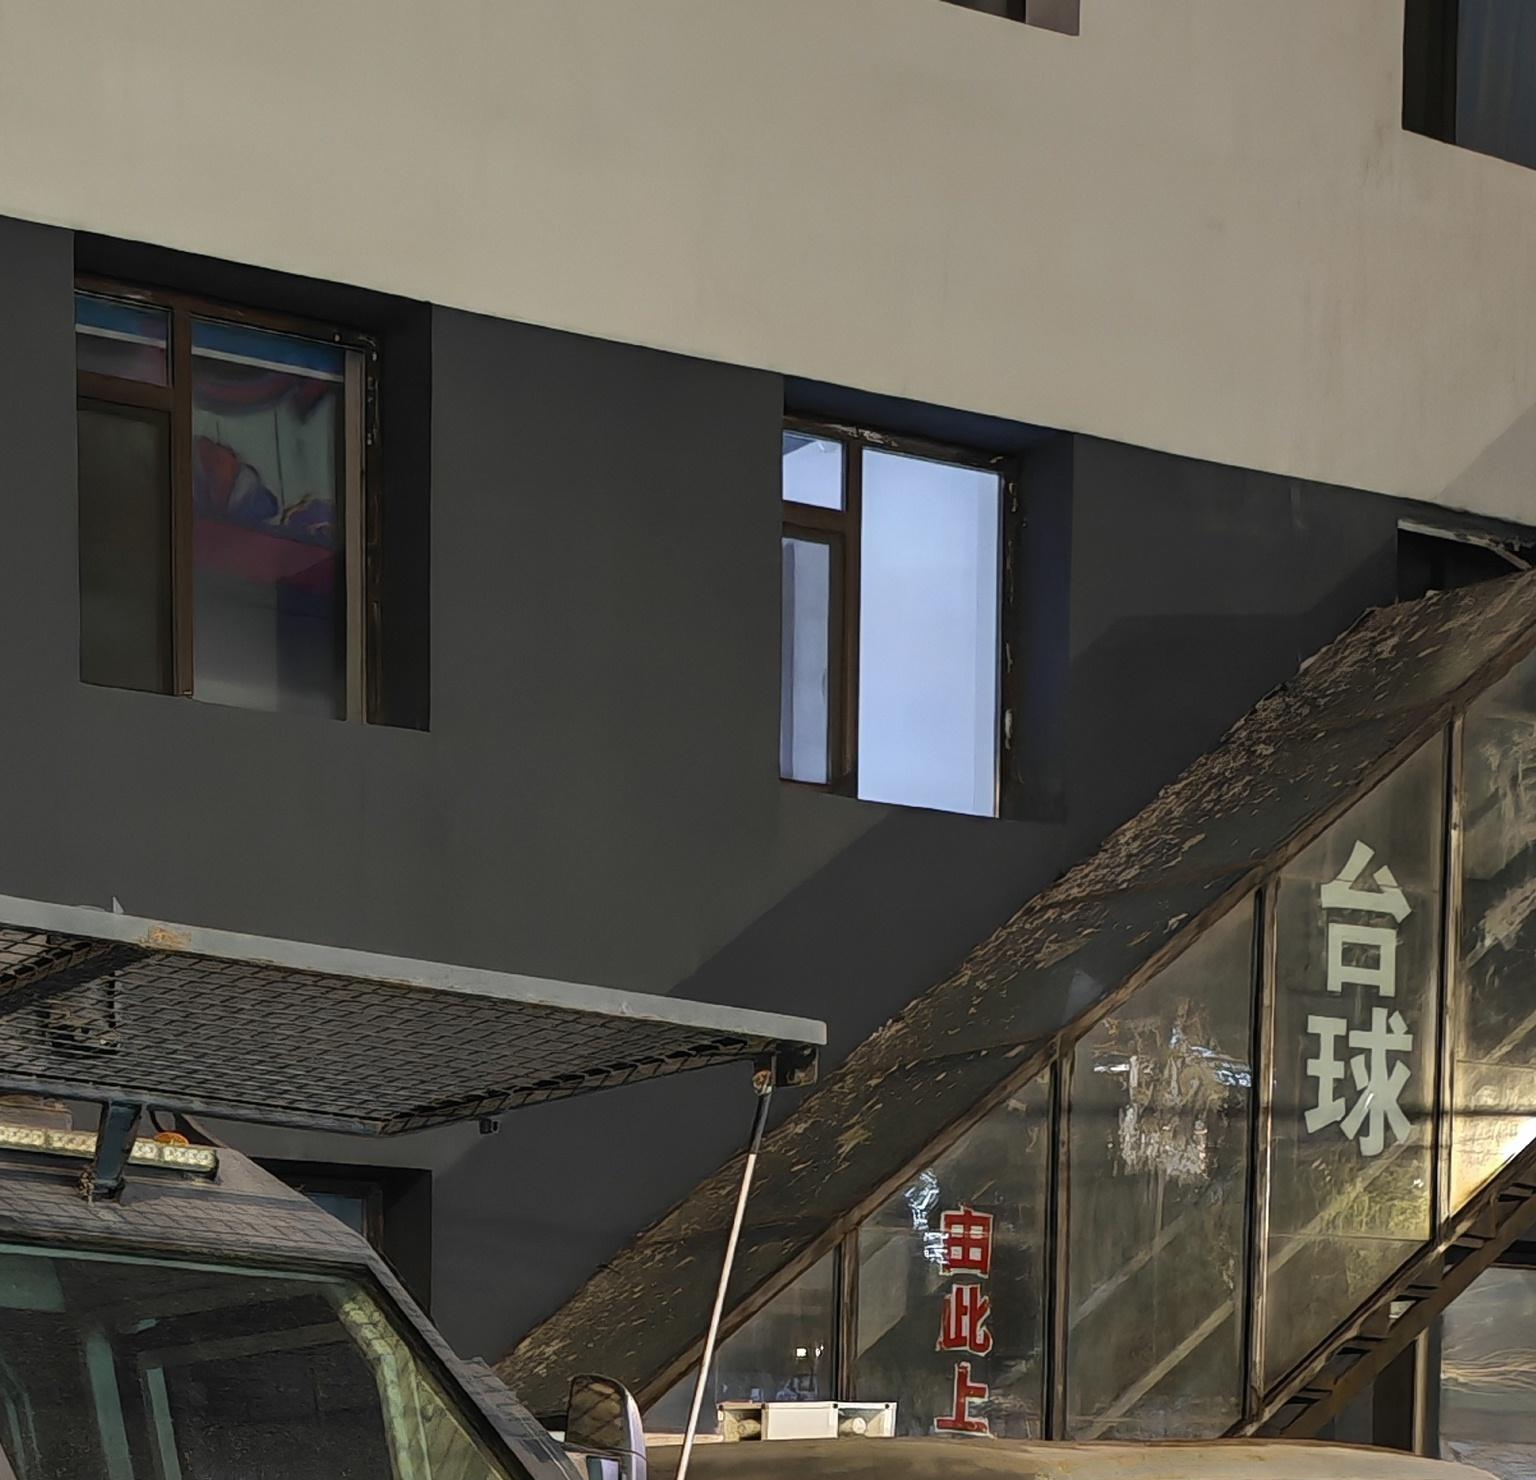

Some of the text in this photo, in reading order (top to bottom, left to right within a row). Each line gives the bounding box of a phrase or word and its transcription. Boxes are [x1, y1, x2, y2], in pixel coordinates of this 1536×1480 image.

[1304, 839, 1414, 1157] 台球
[933, 1203, 995, 1437] 由此上
